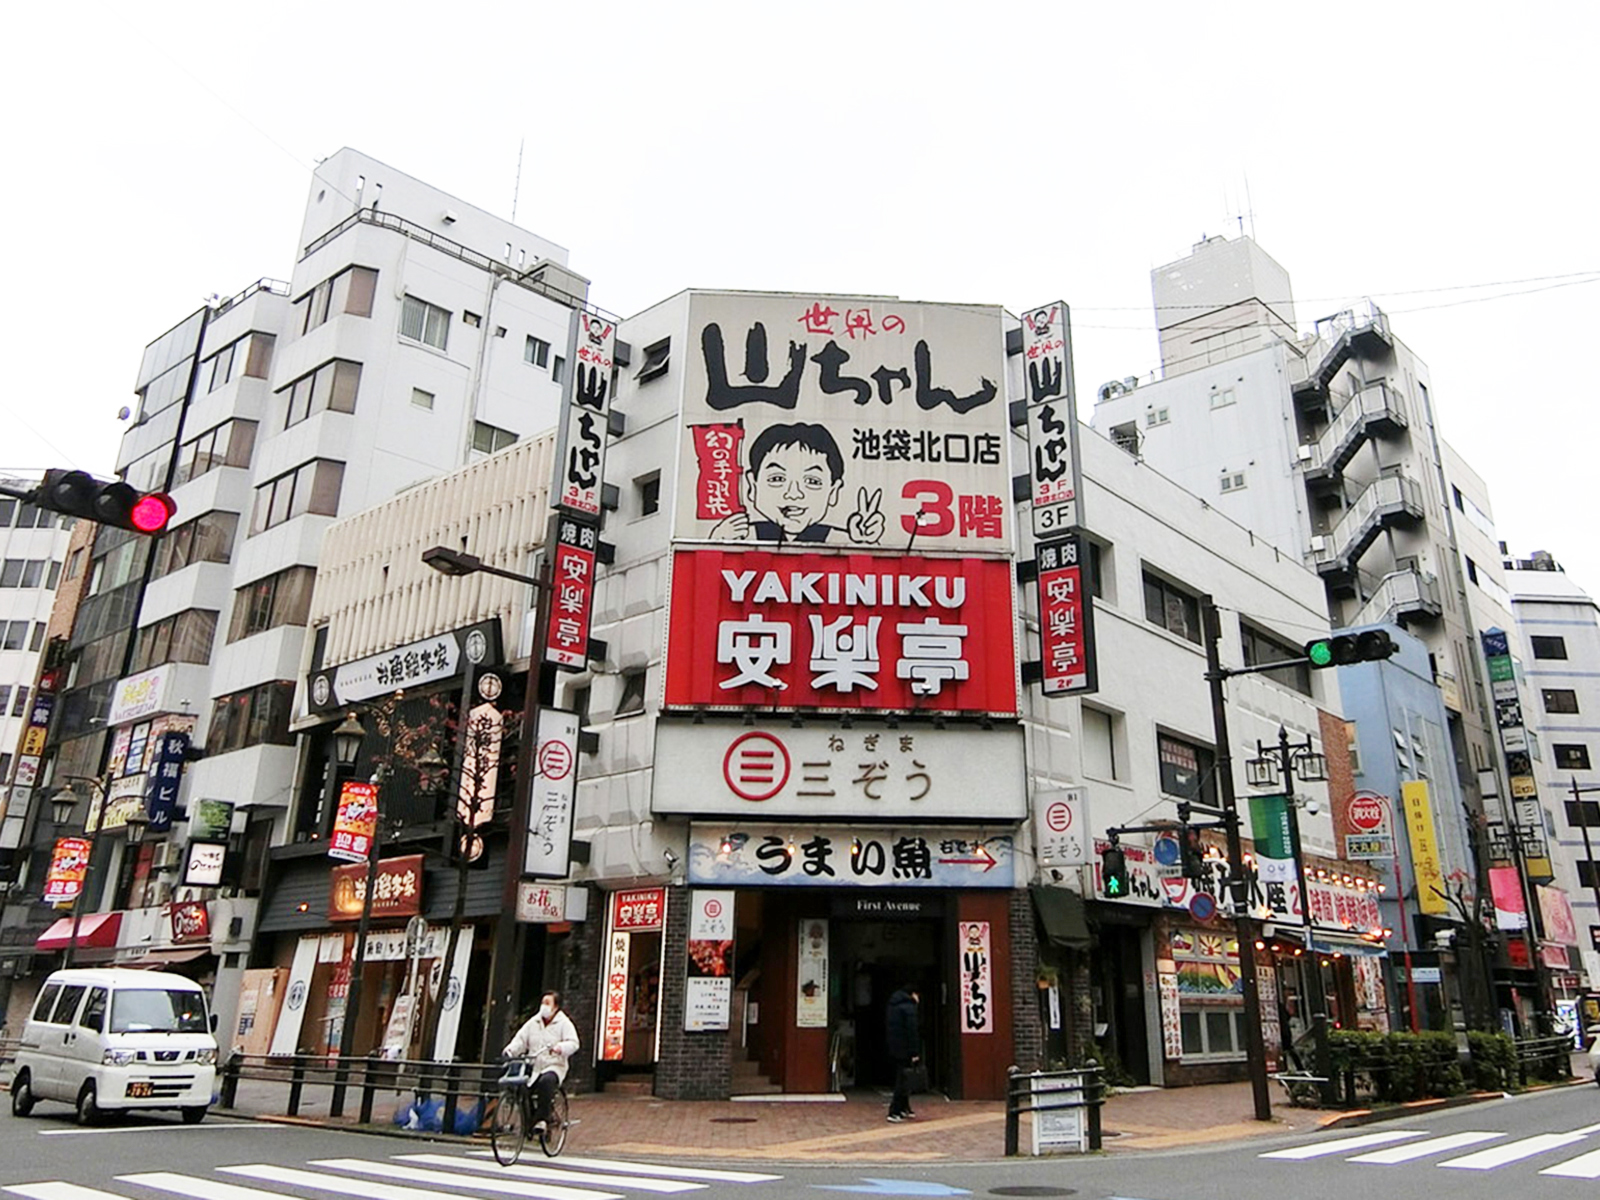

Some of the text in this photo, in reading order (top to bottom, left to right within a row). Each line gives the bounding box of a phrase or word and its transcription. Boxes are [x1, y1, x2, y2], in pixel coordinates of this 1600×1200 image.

[798, 302, 905, 340] 世界の
[702, 320, 998, 415] 山ちゃん
[853, 428, 1001, 464] 池袋北口店
[705, 430, 733, 515] 幻の手羽先
[901, 479, 1003, 539] 3階
[1041, 506, 1069, 528] 3F
[561, 521, 595, 549] 焼肉
[1041, 543, 1077, 569] 焼肉
[556, 555, 588, 647] 安楽亭
[721, 570, 966, 609] YAKINIKU
[1047, 577, 1078, 672] 安楽亭
[717, 613, 969, 695] 安楽亭
[828, 734, 914, 753] ねぎま
[153, 739, 184, 825] 秋福ビル
[796, 759, 932, 801] 三ぞう
[1353, 805, 1380, 820] 消火栓
[756, 835, 933, 880] うまい魚
[1043, 843, 1081, 859] 三ぞう
[619, 903, 659, 925] 安楽亭
[621, 891, 659, 903] YAKINIKU
[857, 900, 920, 911] First Avenue
